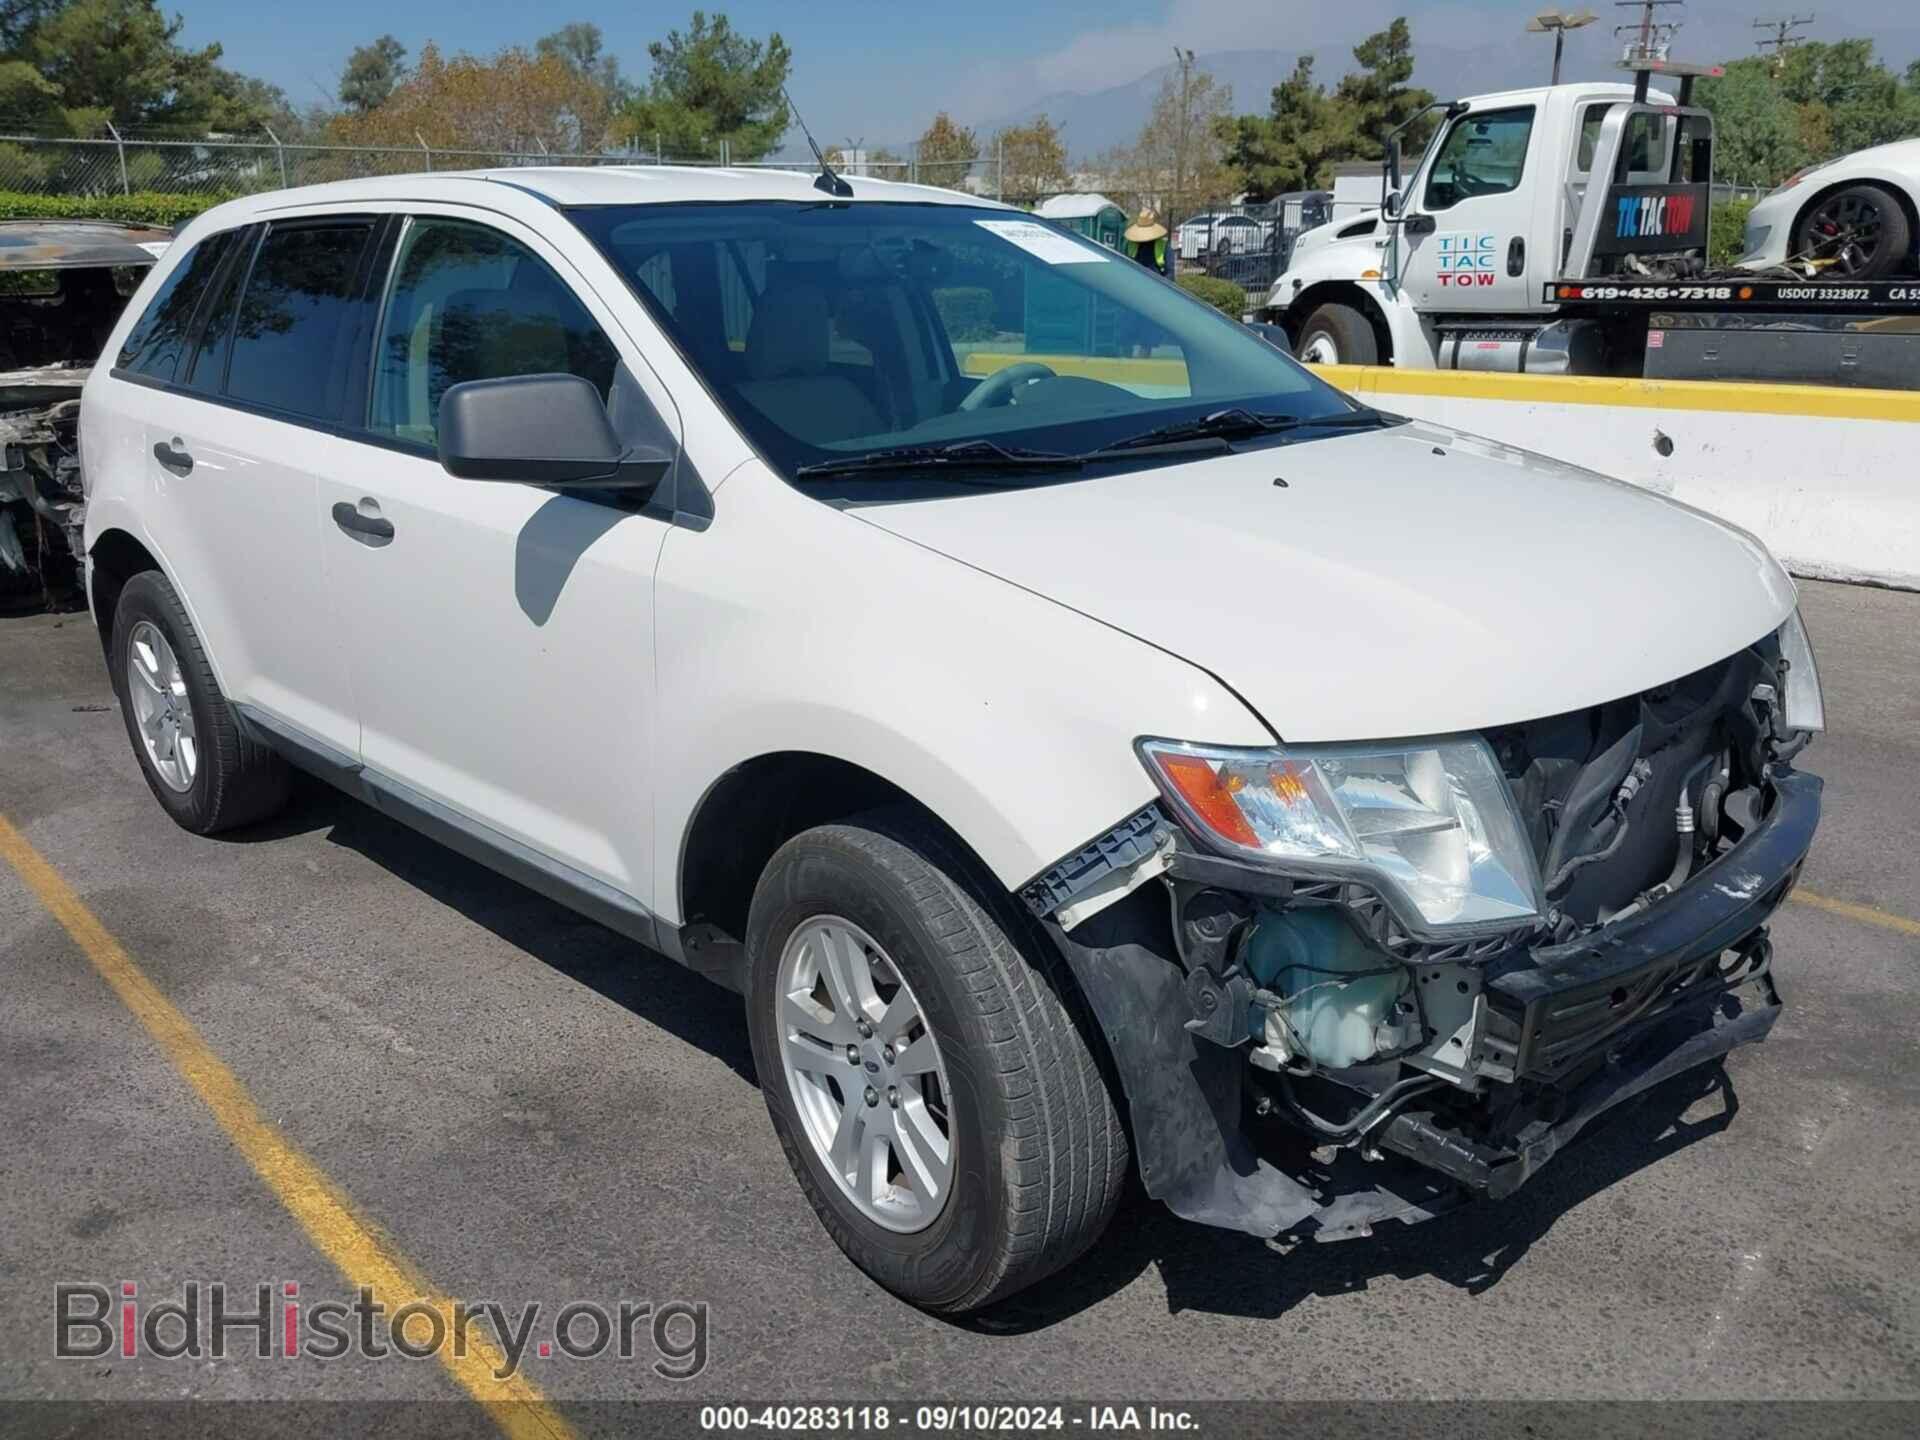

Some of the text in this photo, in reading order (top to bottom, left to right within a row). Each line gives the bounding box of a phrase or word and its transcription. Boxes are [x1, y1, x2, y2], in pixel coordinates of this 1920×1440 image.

[1616, 194, 1695, 238] TIC TAC TOW
[1439, 236, 1495, 250] TIC
[1438, 254, 1495, 268] TAC
[1437, 274, 1495, 286] TOW
[1777, 287, 1870, 300] USDOT 3323872
[1889, 288, 1907, 300] CA
